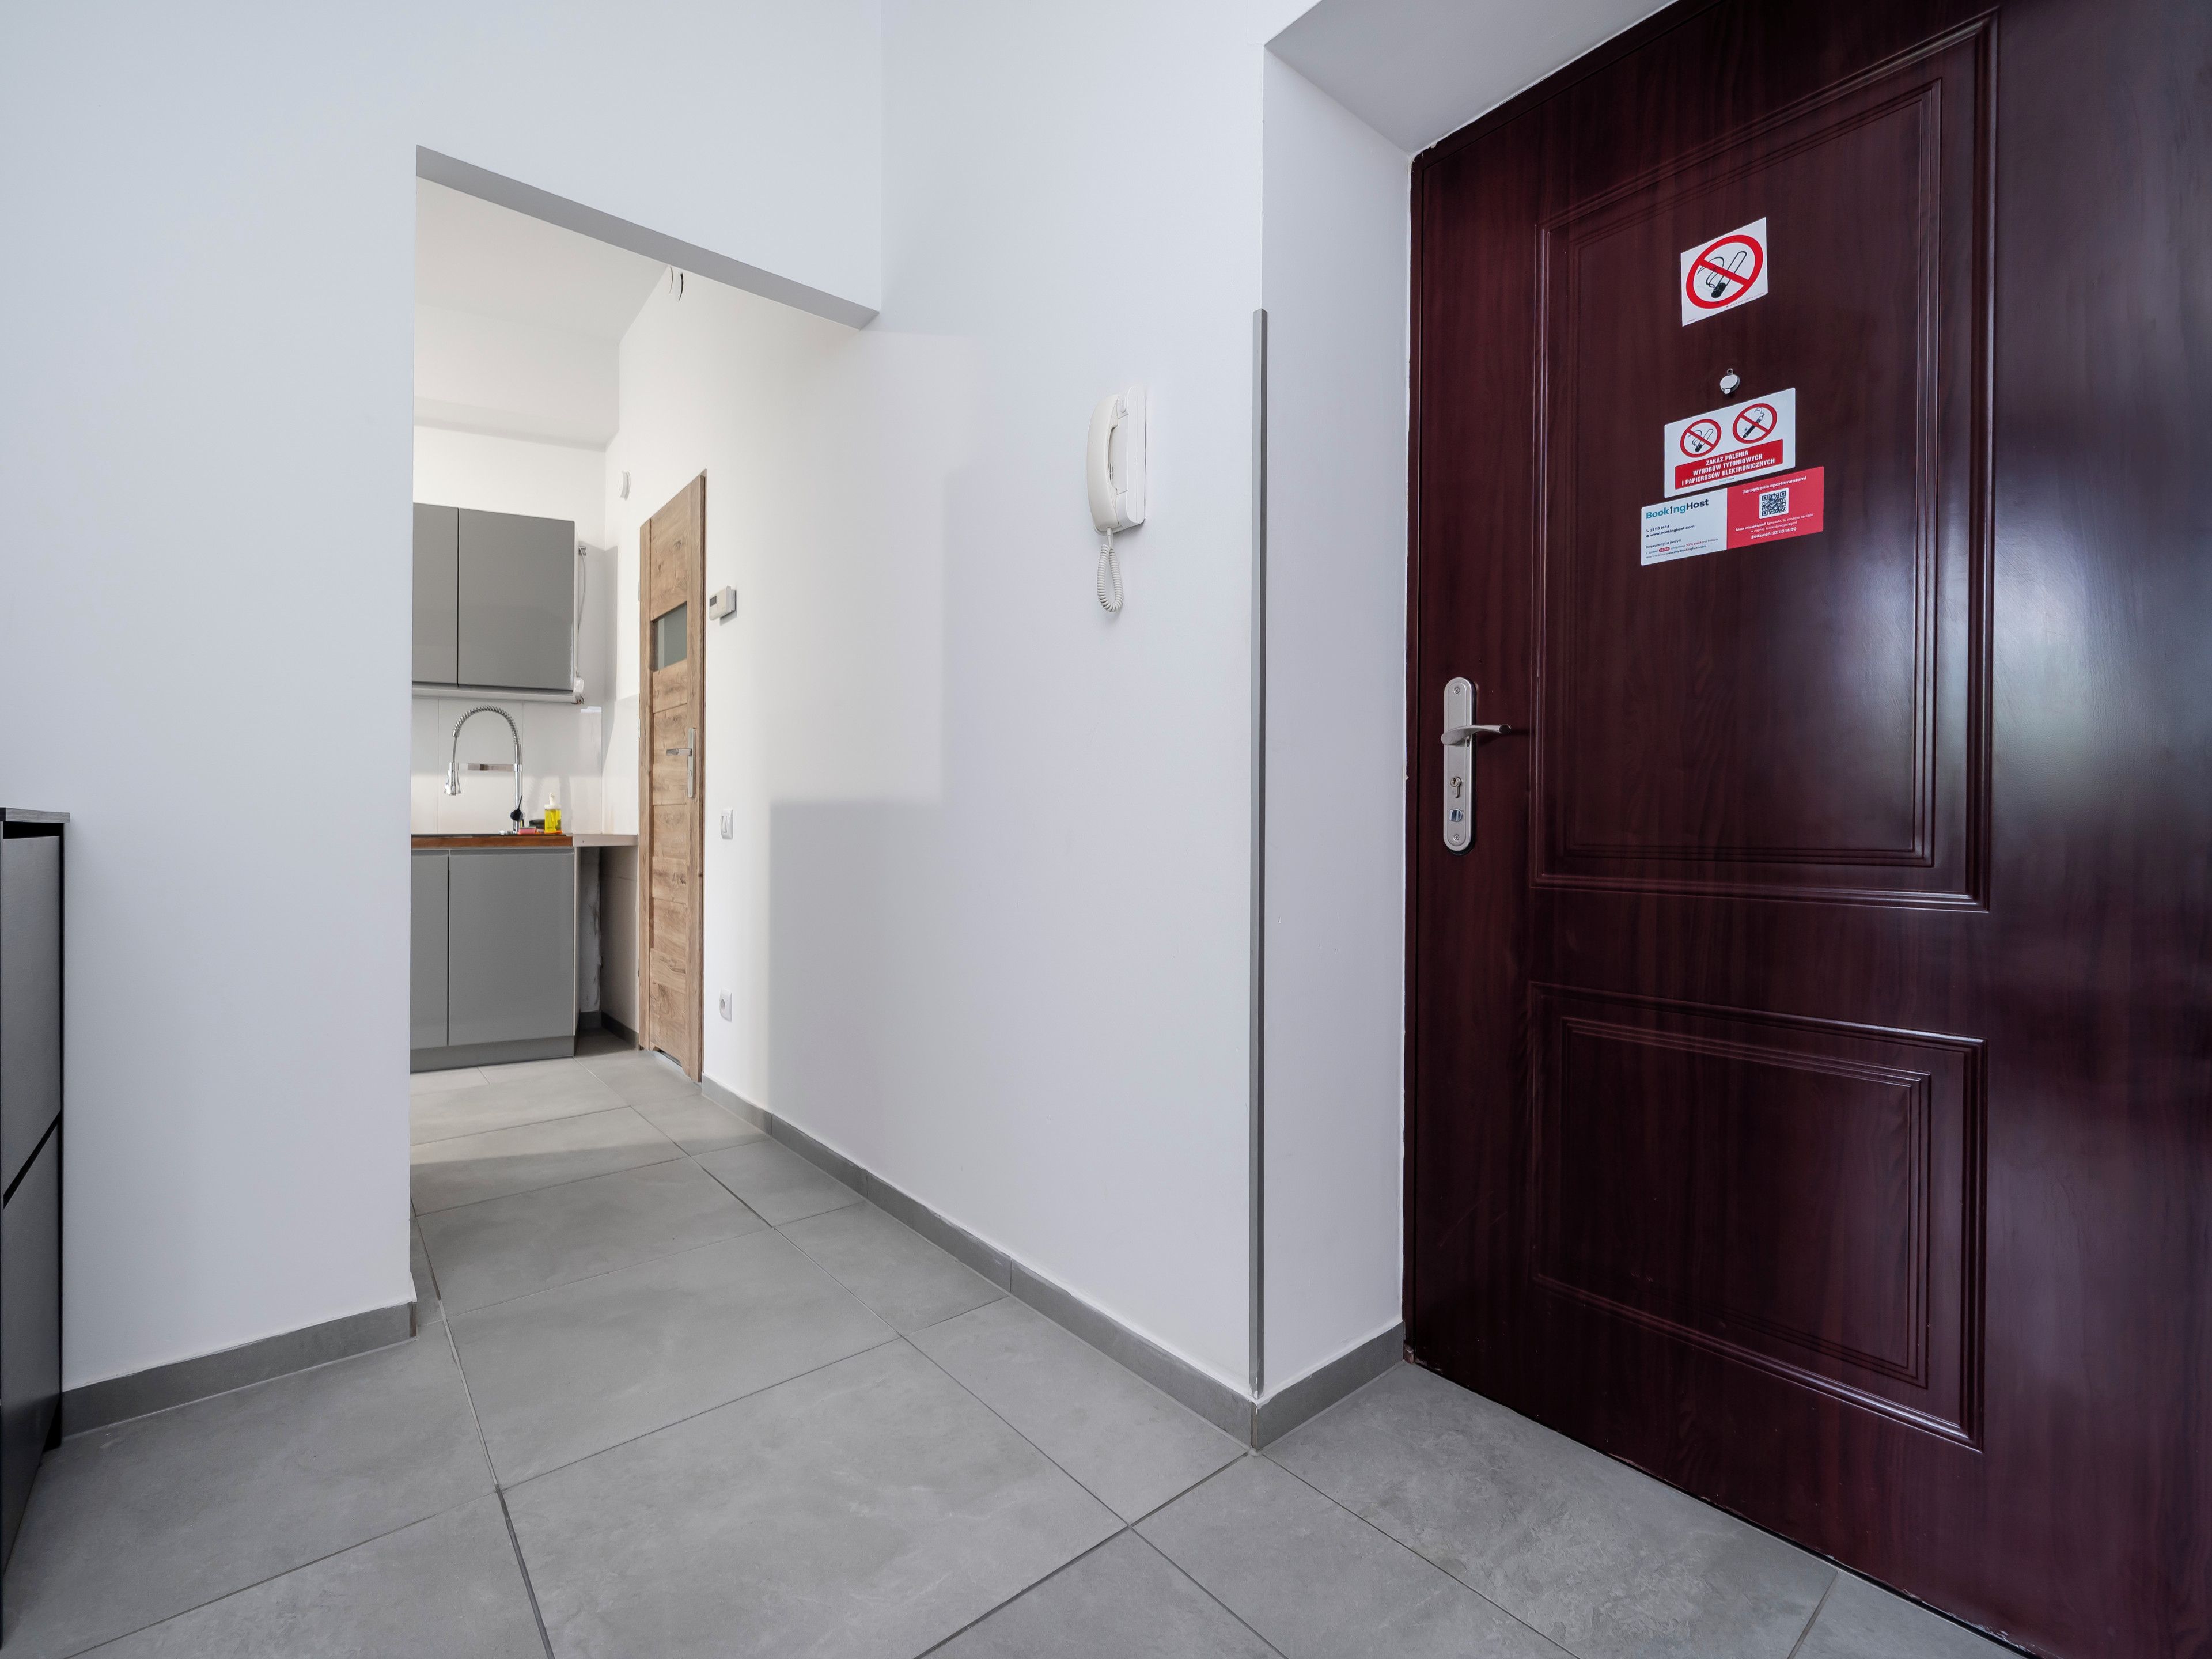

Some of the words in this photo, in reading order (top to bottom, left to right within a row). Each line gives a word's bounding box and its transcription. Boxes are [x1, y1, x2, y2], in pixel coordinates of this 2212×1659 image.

[1693, 464, 1722, 476] WYROBÓW
[1722, 453, 1763, 469] TYTONIOWYCH
[1706, 456, 1724, 466] ZAKAZ
[1725, 450, 1749, 461] PALENIA
[1685, 471, 1721, 485] PAPIEROSÓW
[1721, 458, 1775, 476] ELEKTRONICZNYCH
[1770, 476, 1807, 488] apartamentami
[1646, 499, 1709, 519] BookingHost
